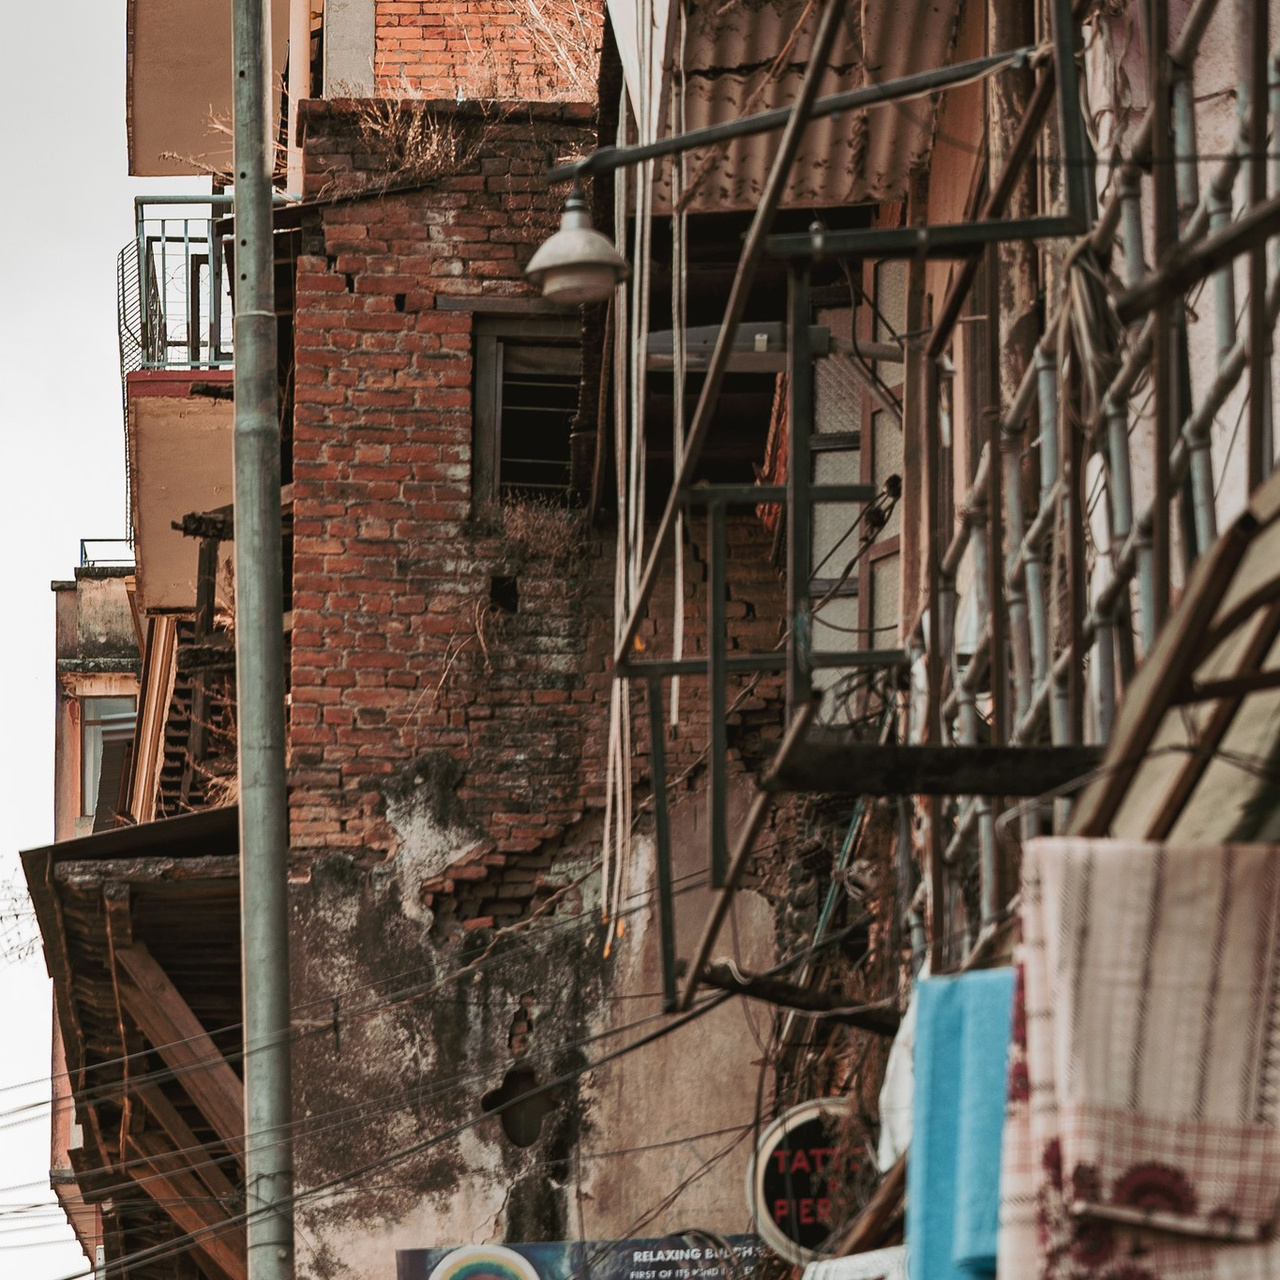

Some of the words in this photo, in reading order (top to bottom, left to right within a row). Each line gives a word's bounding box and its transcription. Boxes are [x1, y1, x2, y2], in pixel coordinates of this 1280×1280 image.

[633, 1248, 701, 1262] RELAXING
[629, 1269, 656, 1280] FIRST
[658, 1269, 673, 1278] OF
[675, 1268, 690, 1278] ITS
